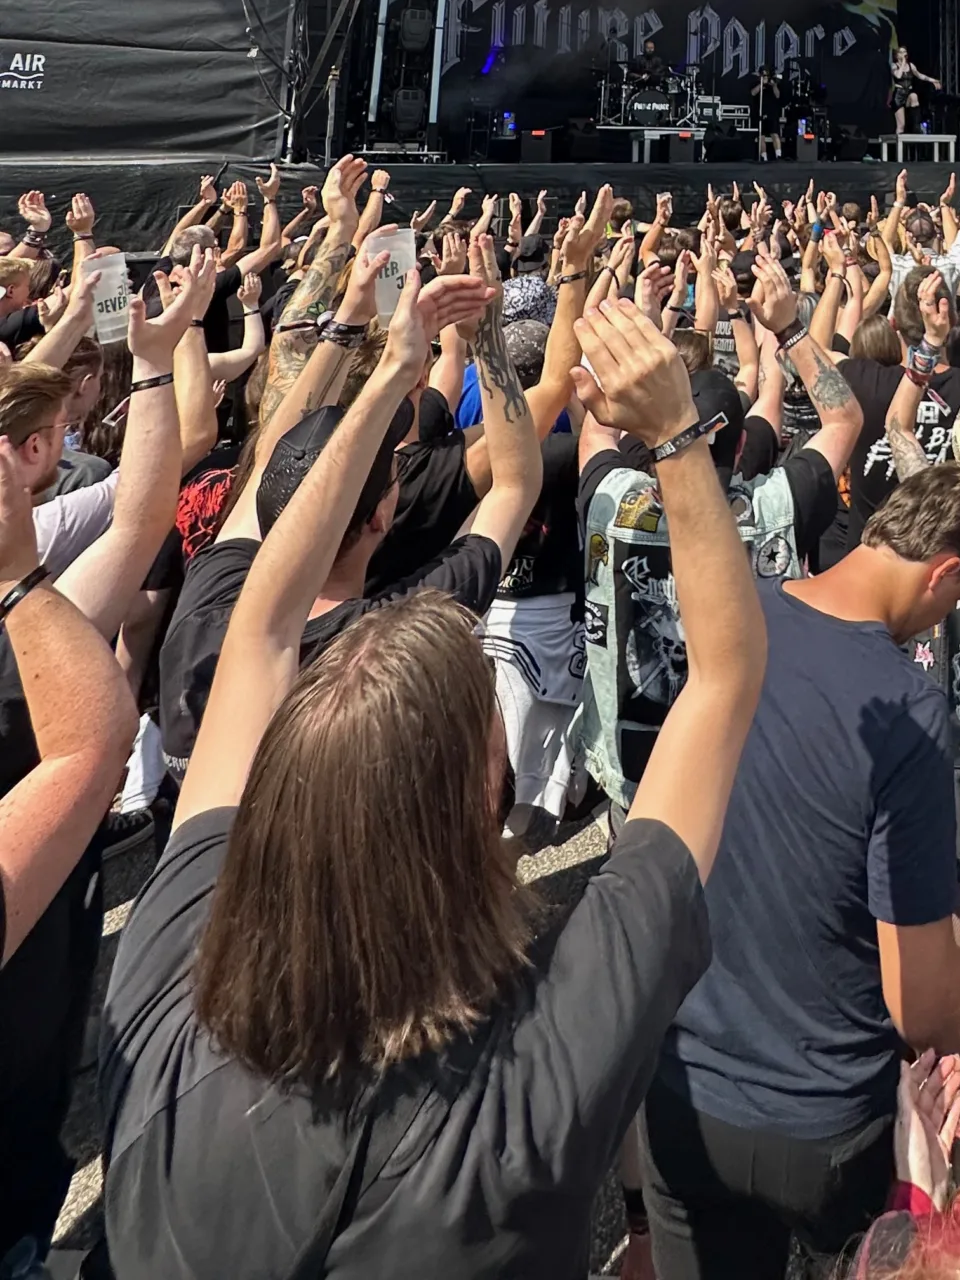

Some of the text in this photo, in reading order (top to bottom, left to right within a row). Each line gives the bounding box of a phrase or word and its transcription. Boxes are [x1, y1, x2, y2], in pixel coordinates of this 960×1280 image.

[9, 53, 46, 72] AIR
[0, 80, 43, 89] MARKT
[97, 296, 128, 314] JEVER
